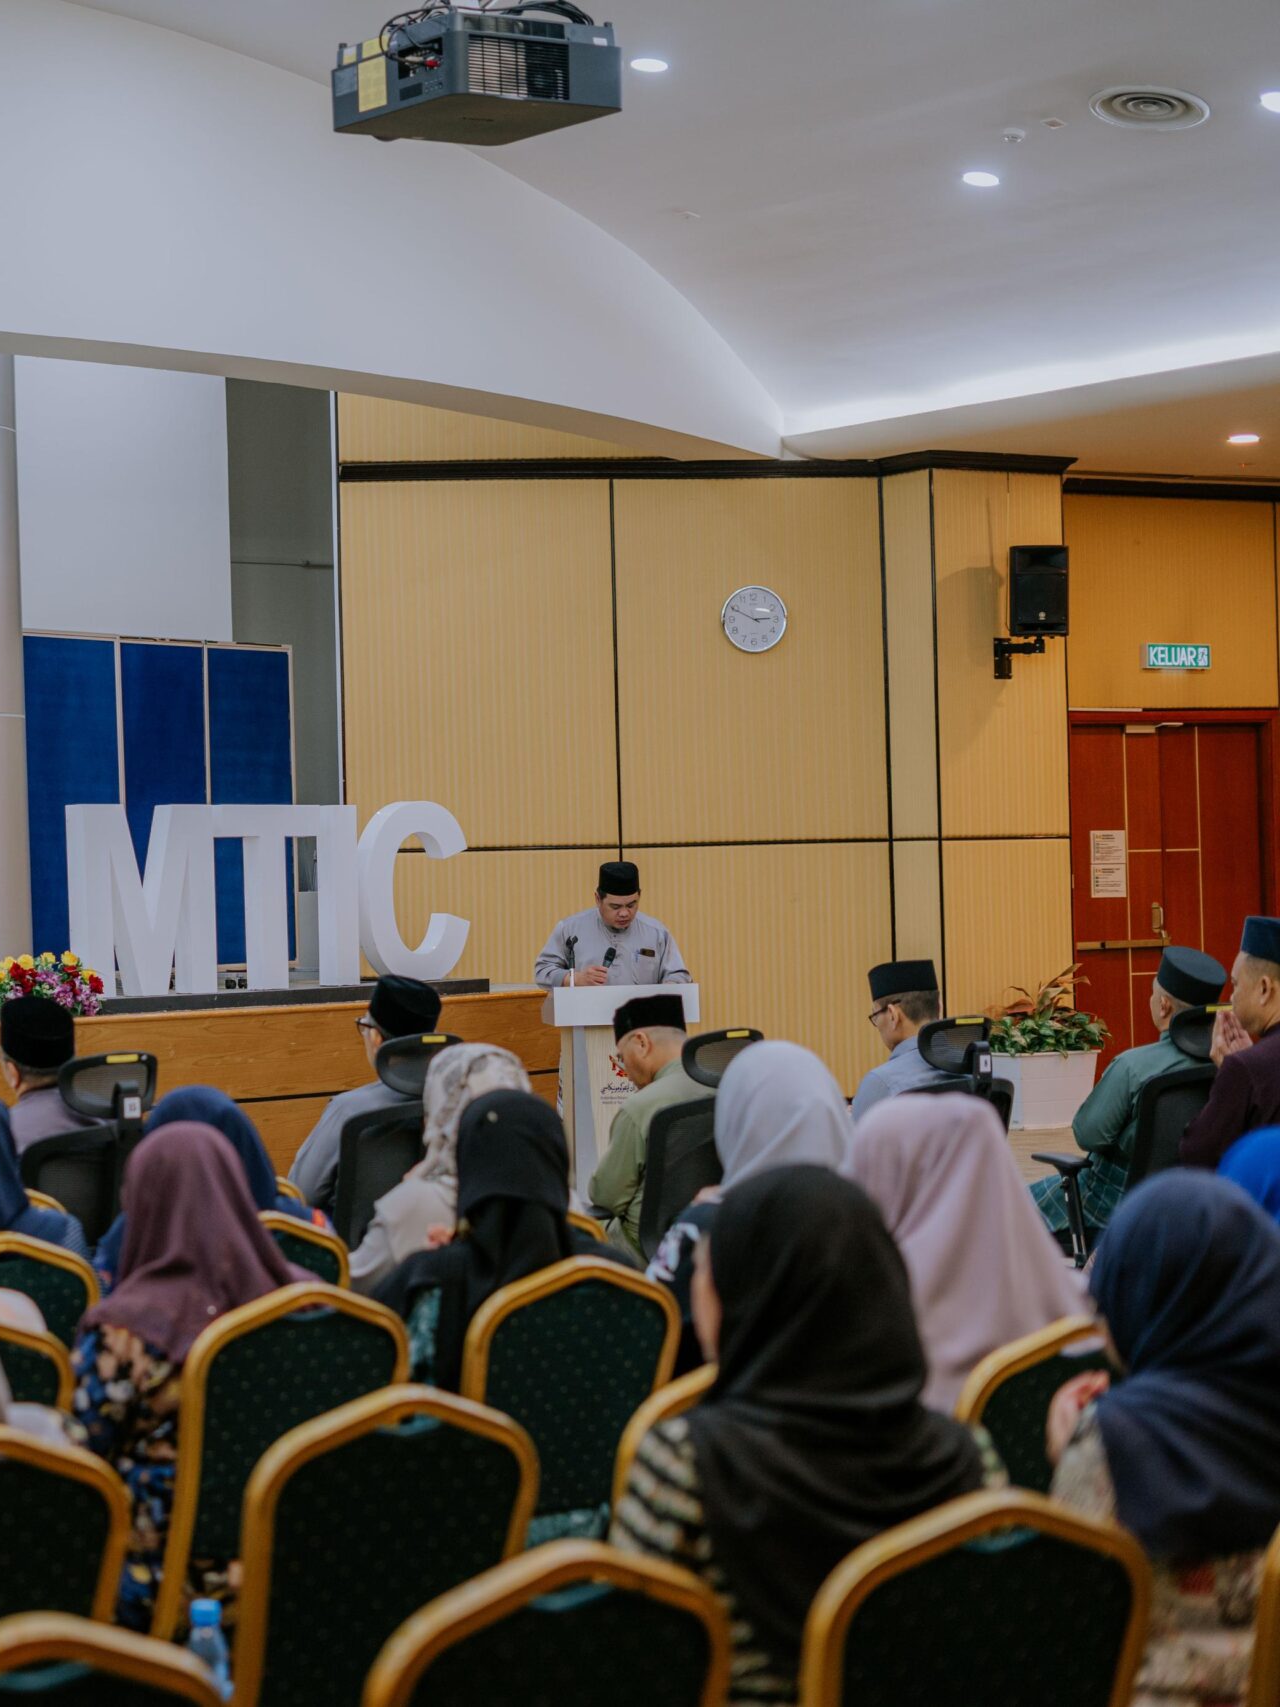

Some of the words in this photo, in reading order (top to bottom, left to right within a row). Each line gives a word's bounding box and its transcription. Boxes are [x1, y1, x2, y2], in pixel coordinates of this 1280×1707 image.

[749, 593, 757, 601] 12
[773, 615, 779, 623] 3
[751, 638, 757, 646] 6
[1149, 646, 1197, 666] KELUAR
[64, 800, 470, 997] MTIC
